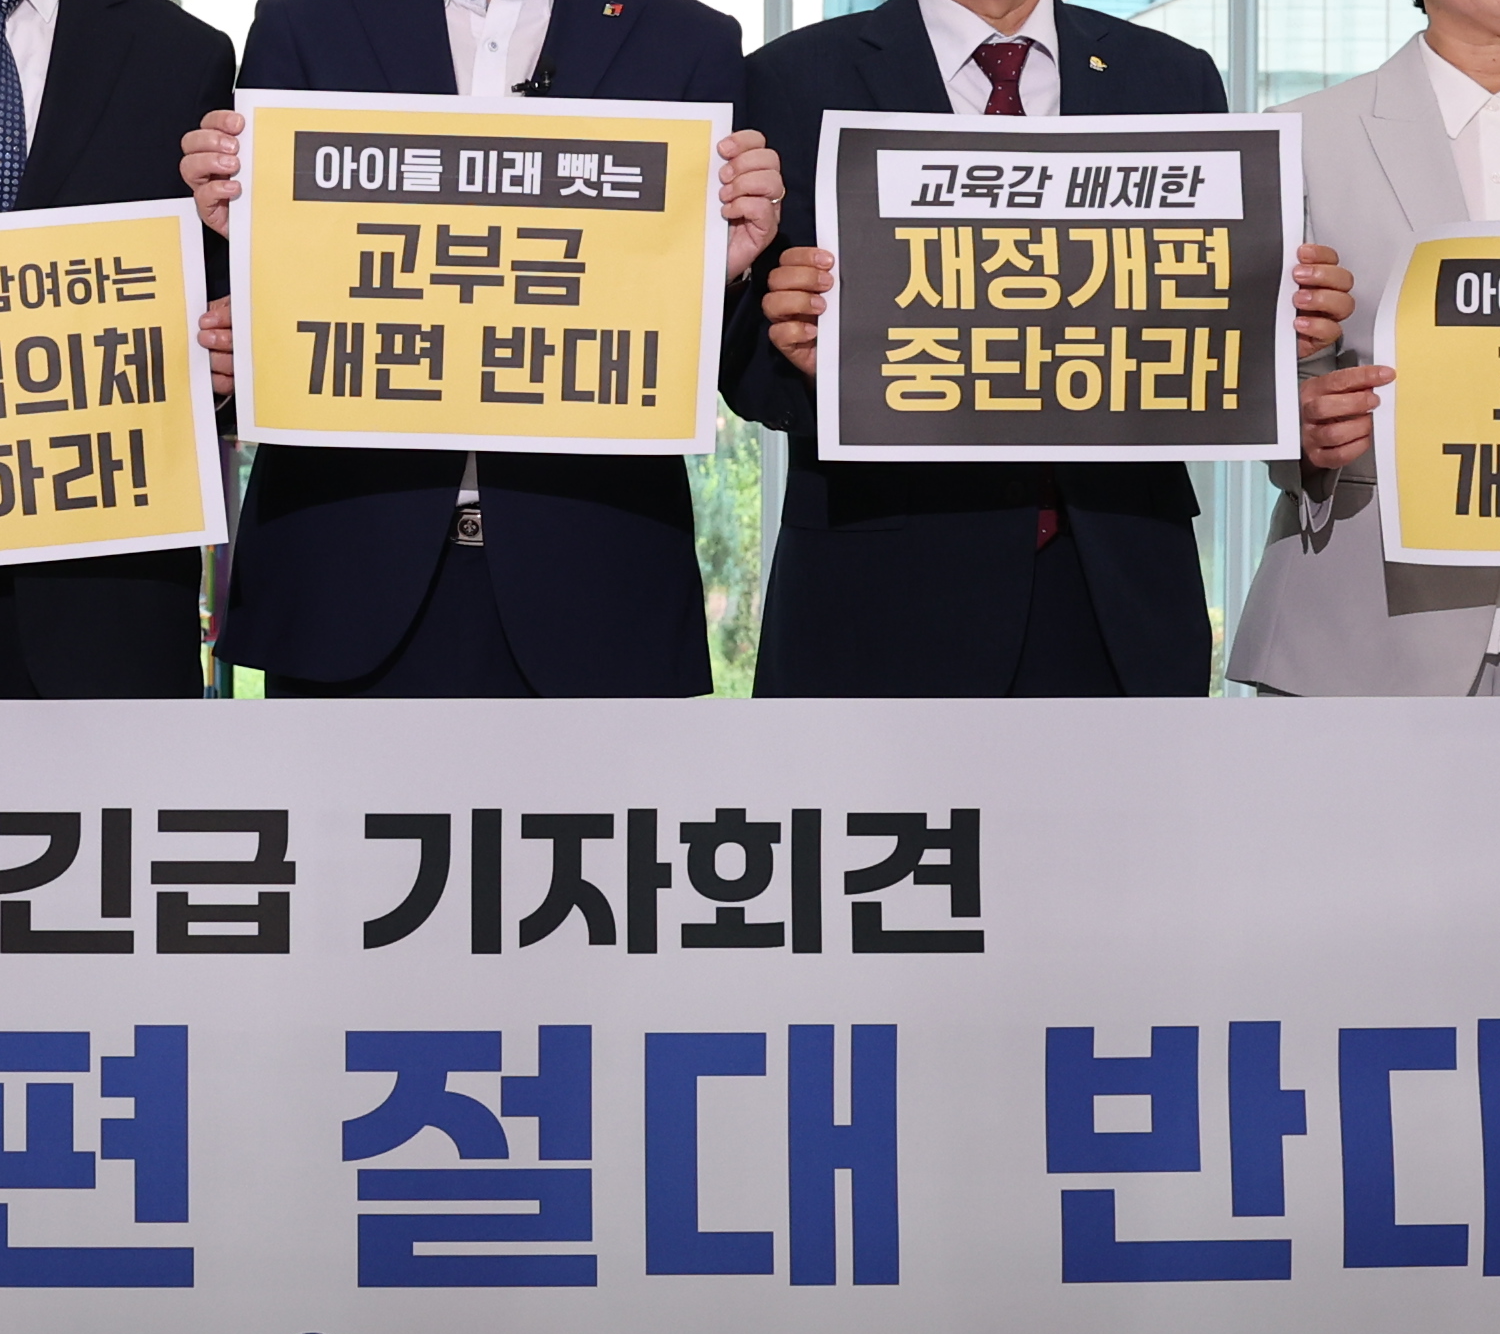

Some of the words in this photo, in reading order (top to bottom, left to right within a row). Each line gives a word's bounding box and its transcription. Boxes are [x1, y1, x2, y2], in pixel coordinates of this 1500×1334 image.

[314, 145, 443, 192] 아이들
[458, 149, 543, 195] 미래
[556, 152, 643, 199] 뺏는
[910, 164, 1053, 209] 교육감
[1064, 165, 1206, 209] 배제한
[348, 222, 586, 307] 교부금
[894, 226, 1231, 311] 재정개편
[296, 320, 445, 402] 개편
[480, 325, 659, 407] 반대!
[880, 326, 1241, 412] 중단하라!
[363, 807, 985, 955] 기자회견
[341, 1023, 900, 1289] 절대
